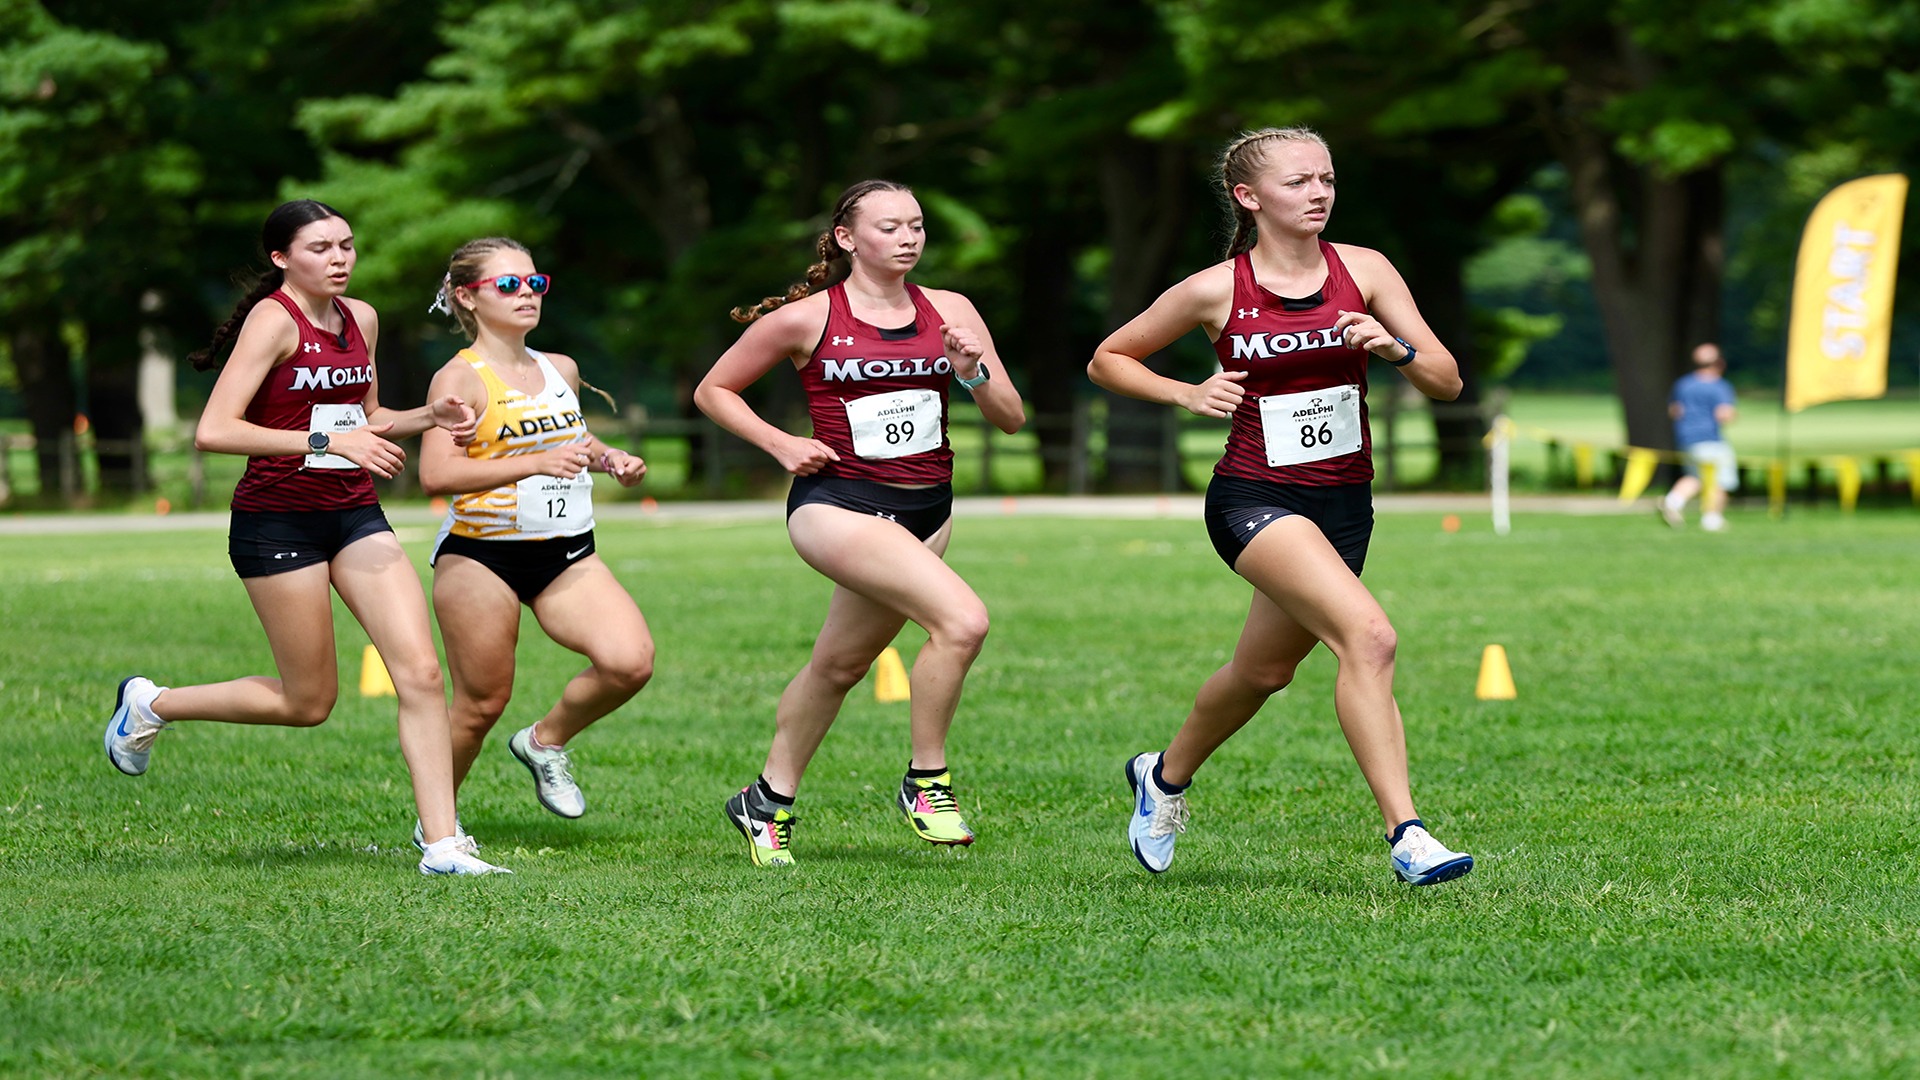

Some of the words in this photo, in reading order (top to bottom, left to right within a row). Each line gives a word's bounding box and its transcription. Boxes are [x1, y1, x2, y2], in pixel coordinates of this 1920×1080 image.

[1820, 220, 1876, 360] START
[877, 404, 915, 417] ADELPHI
[1292, 404, 1334, 418] ADELPHI
[885, 420, 915, 445] 89
[1300, 421, 1333, 448] 86
[547, 498, 566, 518] 12
